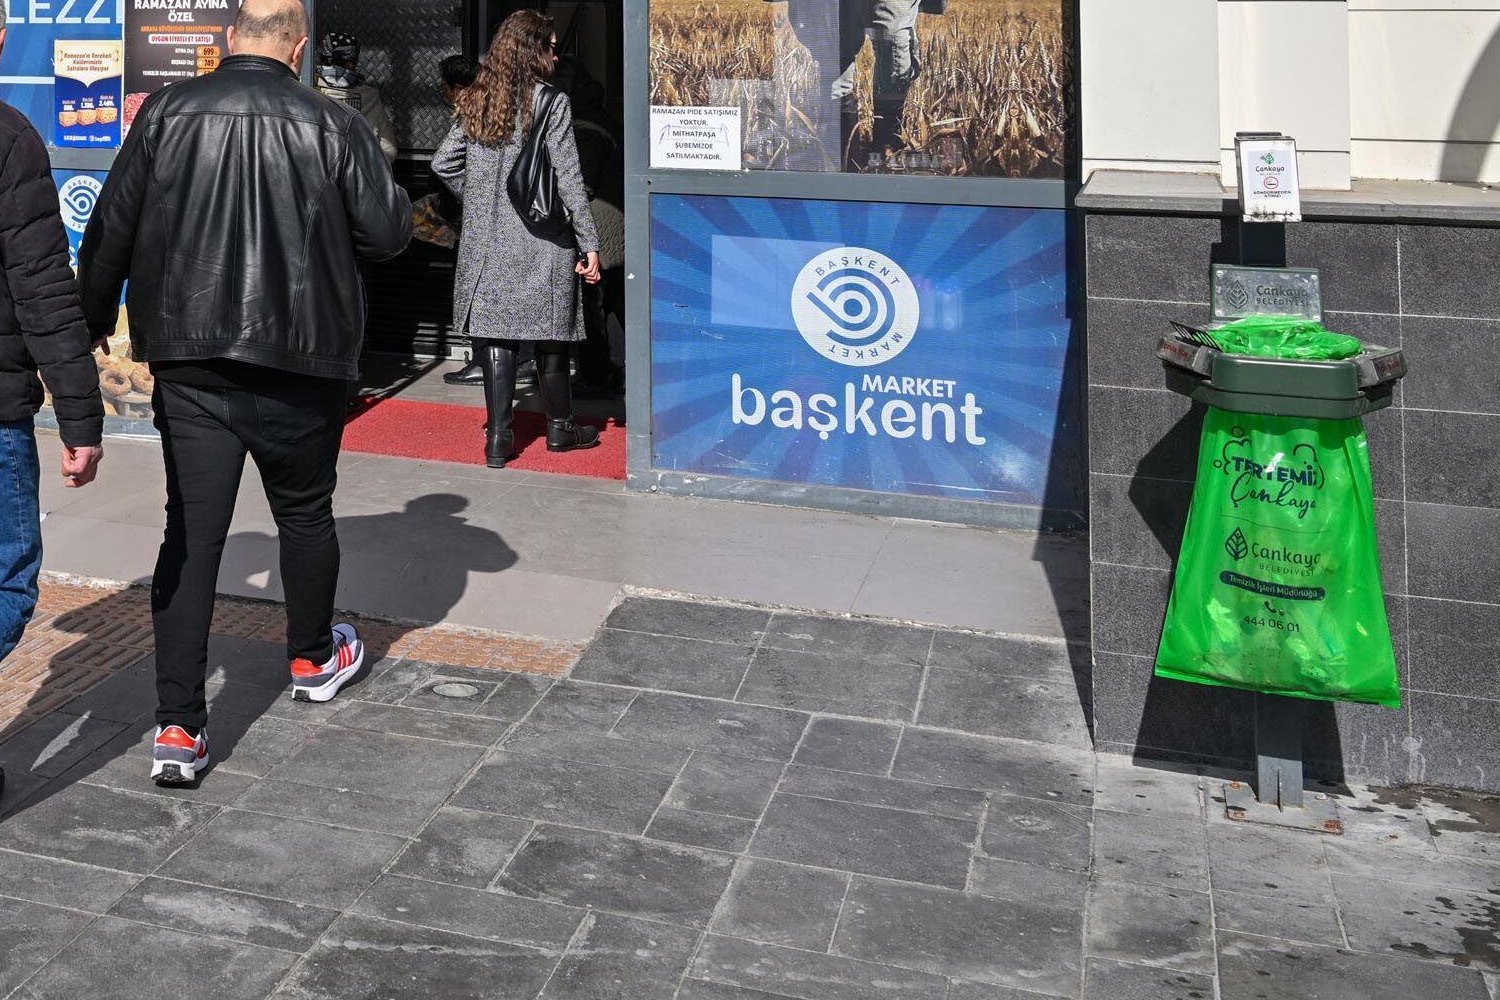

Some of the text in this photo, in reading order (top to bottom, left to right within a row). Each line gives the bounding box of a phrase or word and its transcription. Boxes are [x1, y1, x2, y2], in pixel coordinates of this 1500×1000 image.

[168, 9, 195, 22] ÖZEL
[687, 107, 702, 115] PİDE
[703, 109, 738, 117] SATIŞIMIZ
[672, 129, 716, 139] MİTHATPAŞA
[675, 141, 713, 150] ŞUBEMİZDE
[666, 152, 722, 161] SATILMAKTADIR.
[1255, 165, 1285, 173] Çankaya
[815, 256, 900, 287] BAŞKENT
[1256, 285, 1309, 299] Çankaya
[828, 332, 904, 360] MARKET
[861, 374, 957, 398] MARKET
[732, 373, 987, 446] başkent
[1243, 615, 1300, 633] 444 06 01
